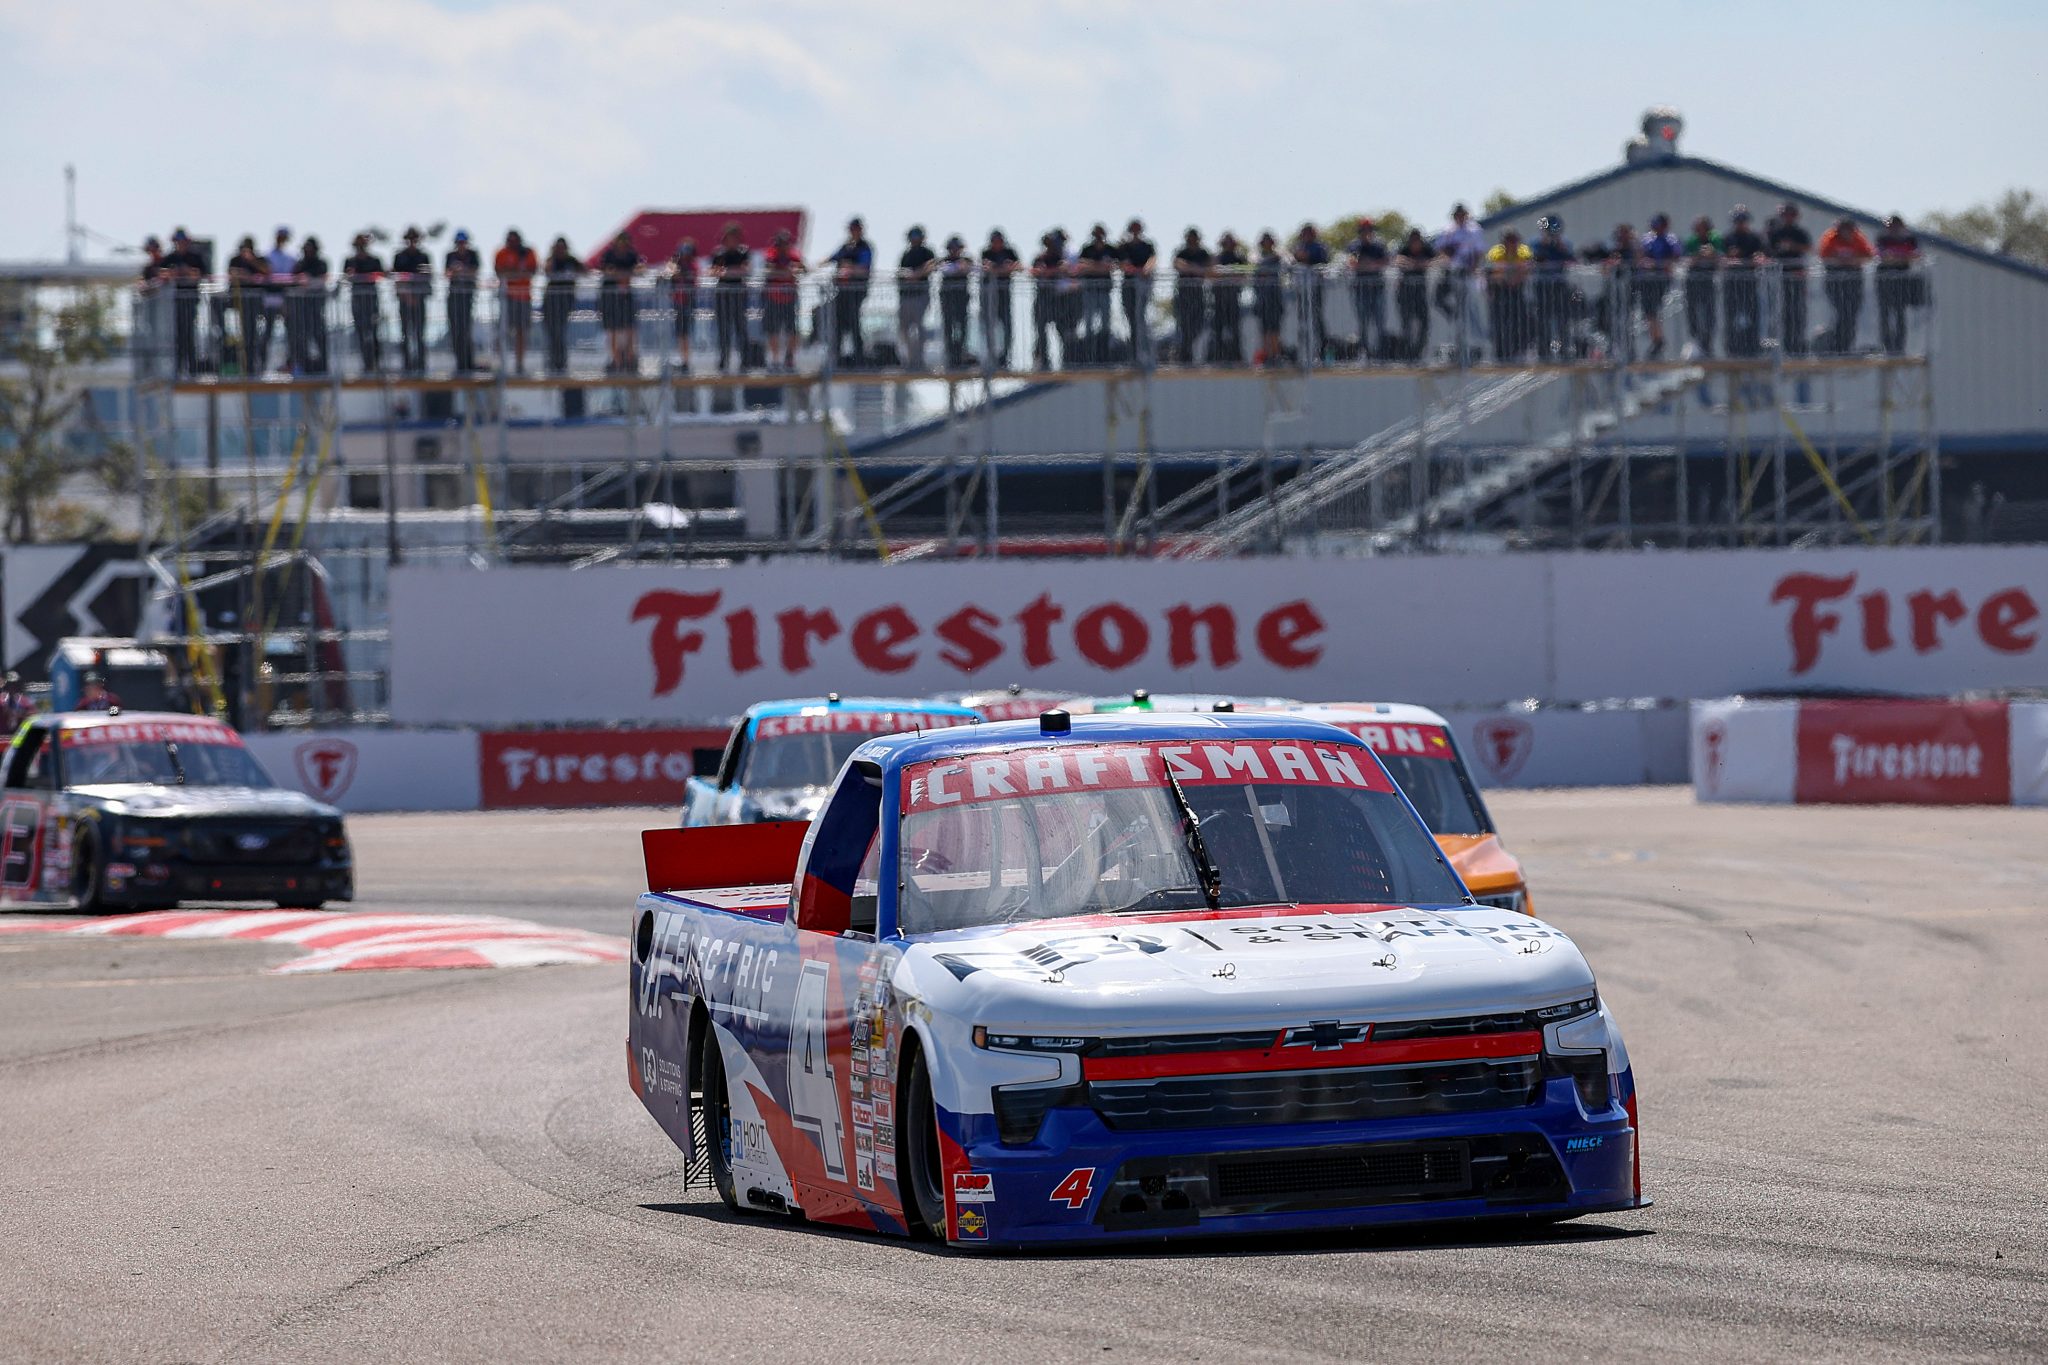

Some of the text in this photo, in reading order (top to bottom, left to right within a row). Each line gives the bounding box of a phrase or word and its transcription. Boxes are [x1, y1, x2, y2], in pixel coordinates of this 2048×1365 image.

[631, 588, 1327, 697] Firestone
[1770, 571, 2039, 676] Fire
[928, 746, 1368, 805] CRAFTSMAN
[1832, 734, 1982, 784] Firestone
[659, 1058, 681, 1078] SOLUTIONS
[787, 958, 849, 1183] 4
[743, 1120, 765, 1150] HOYT
[1567, 1135, 1603, 1149] NIECE
[956, 1175, 990, 1189] ARP
[1050, 1167, 1096, 1208] 4
[959, 1217, 985, 1227] SUNOCO
